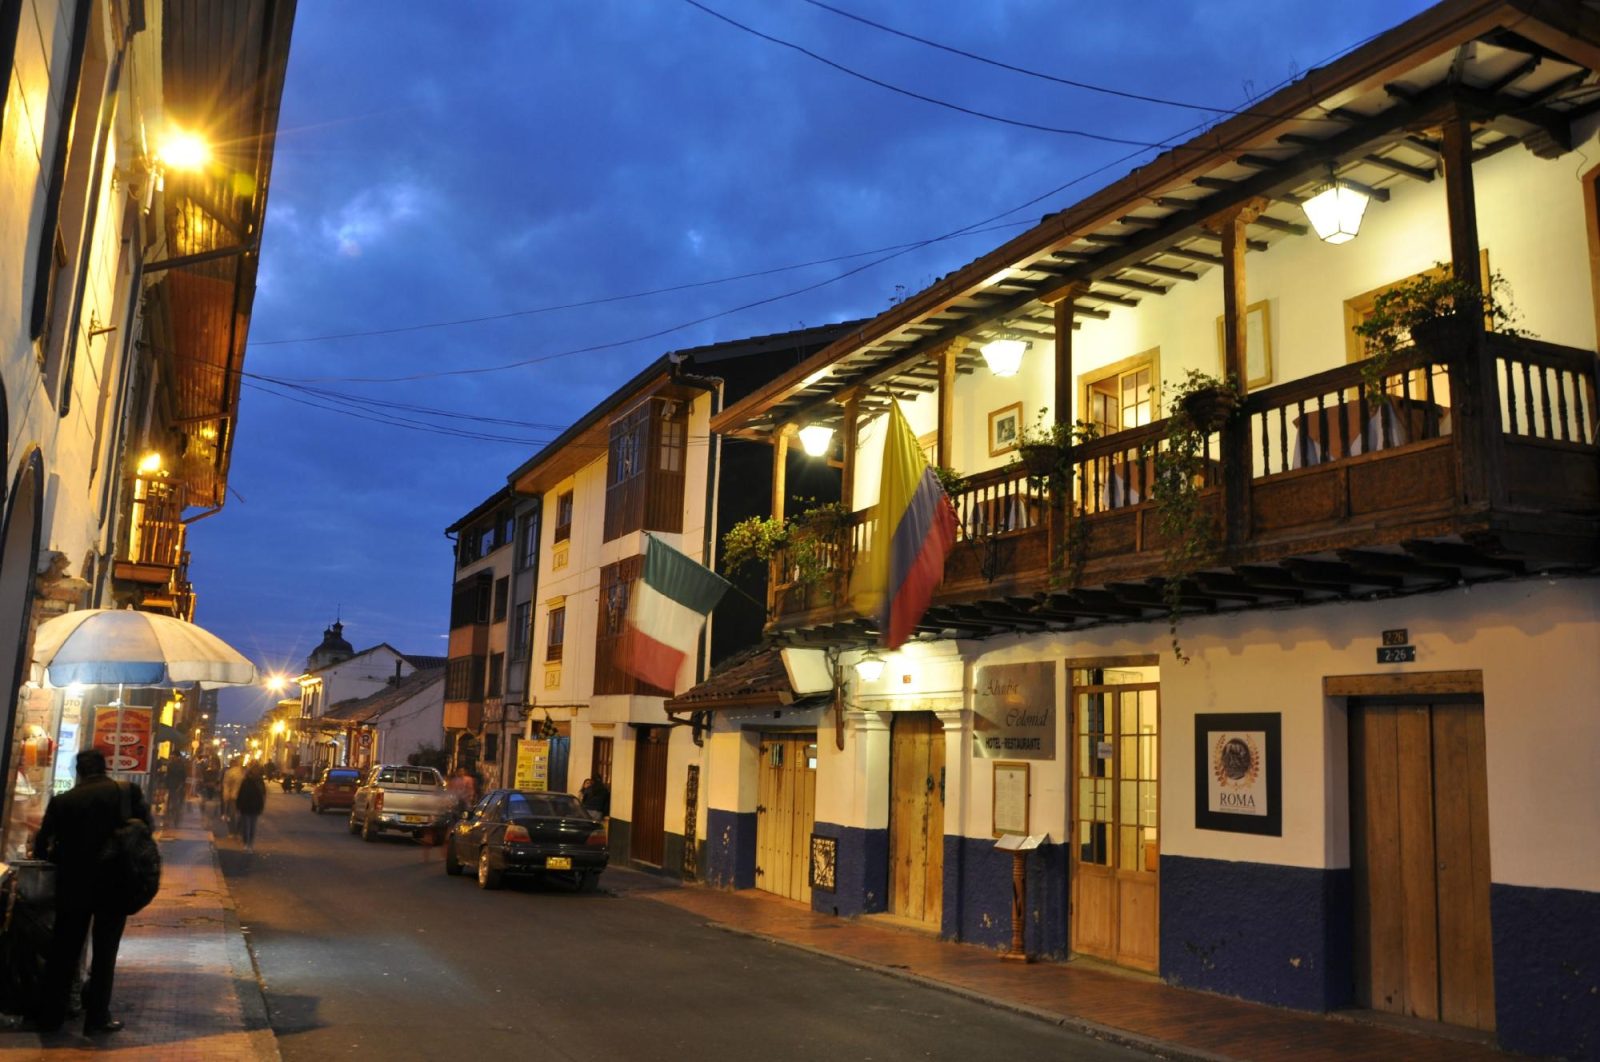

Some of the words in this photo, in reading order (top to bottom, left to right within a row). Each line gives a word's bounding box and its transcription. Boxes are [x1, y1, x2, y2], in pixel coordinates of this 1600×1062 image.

[1384, 650, 1407, 661] 2-26
[1006, 708, 1049, 727] Colonial
[1220, 792, 1256, 807] ROMA
